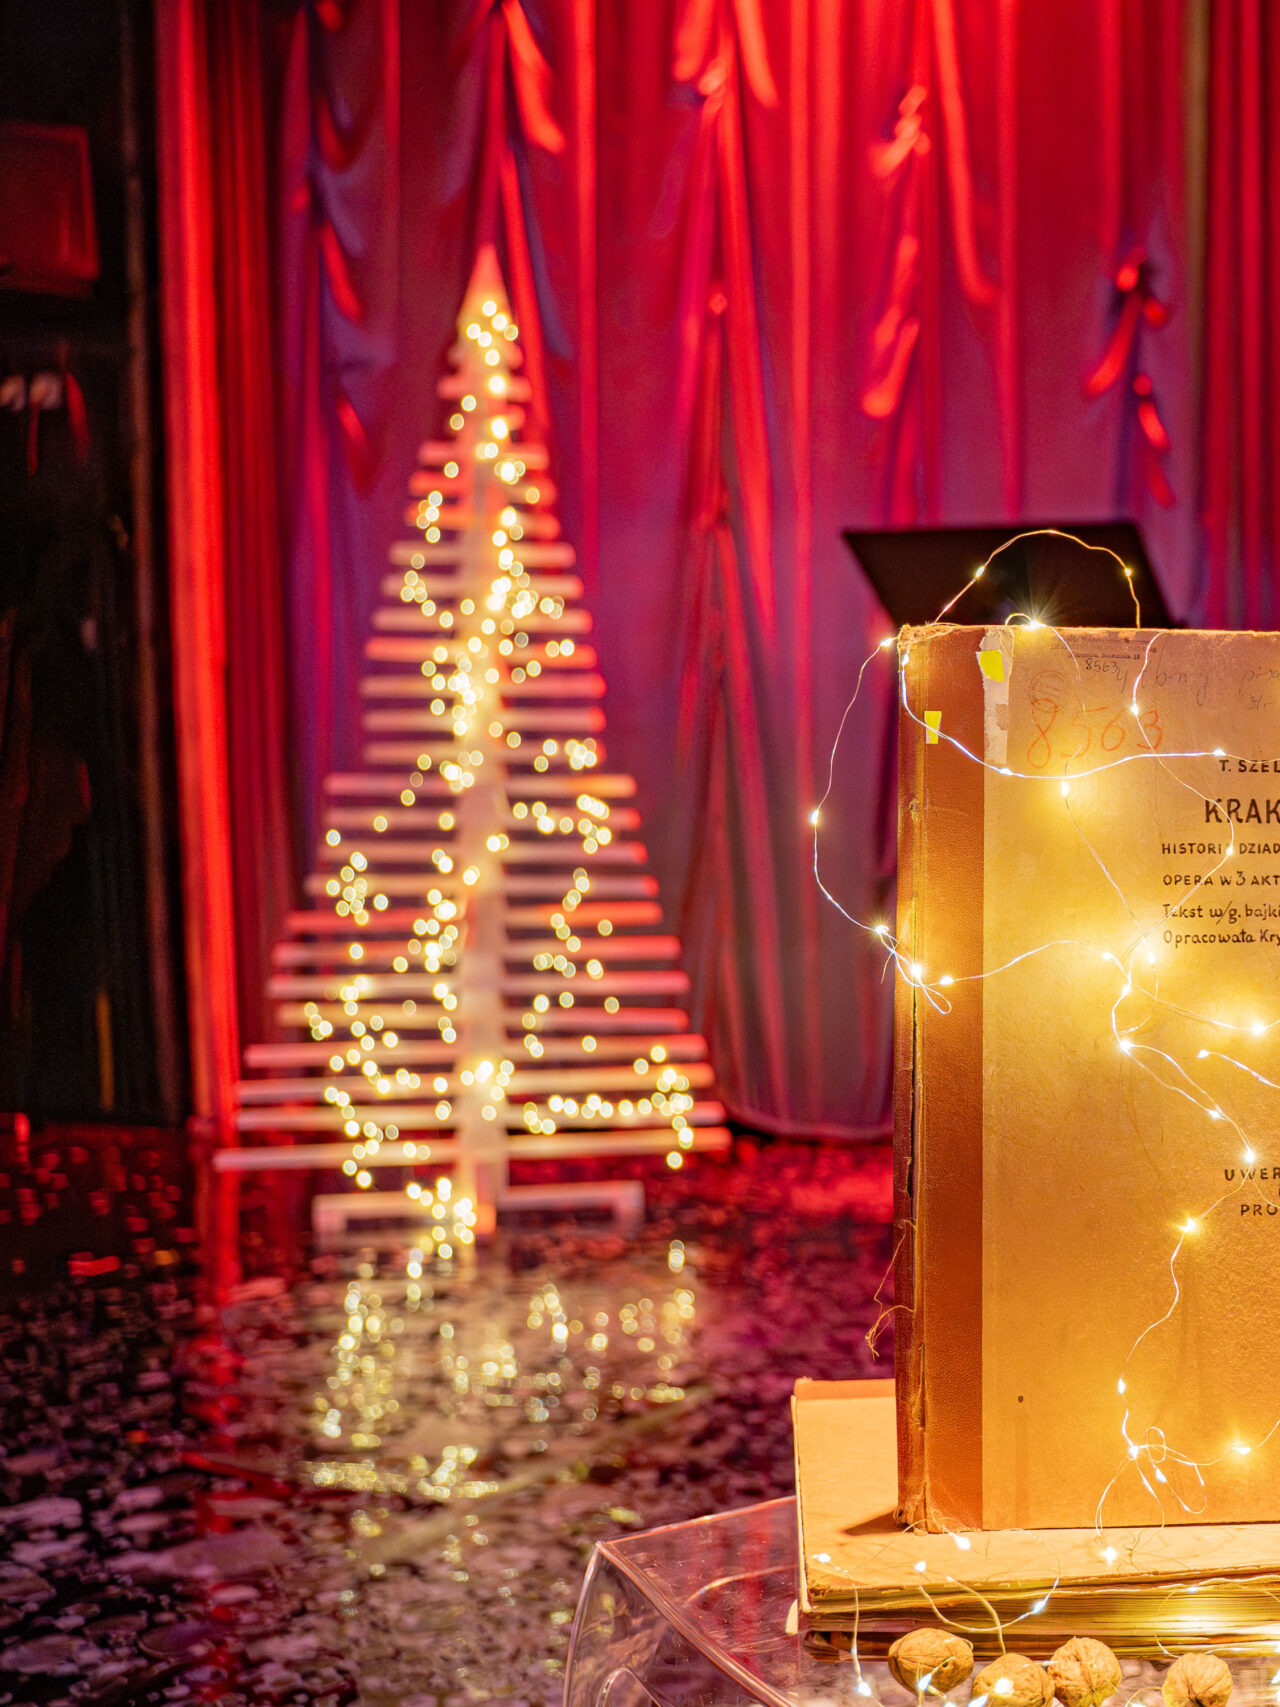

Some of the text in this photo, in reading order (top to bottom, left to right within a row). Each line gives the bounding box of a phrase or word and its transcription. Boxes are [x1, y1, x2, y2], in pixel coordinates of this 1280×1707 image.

[1085, 657, 1119, 673] 8563
[1027, 698, 1163, 769] 8563
[1219, 759, 1231, 772] T.
[1162, 874, 1214, 886] OPERA
[1235, 870, 1246, 886] 3
[1163, 903, 1204, 918] Tekst
[1163, 928, 1257, 948] Opracowała
